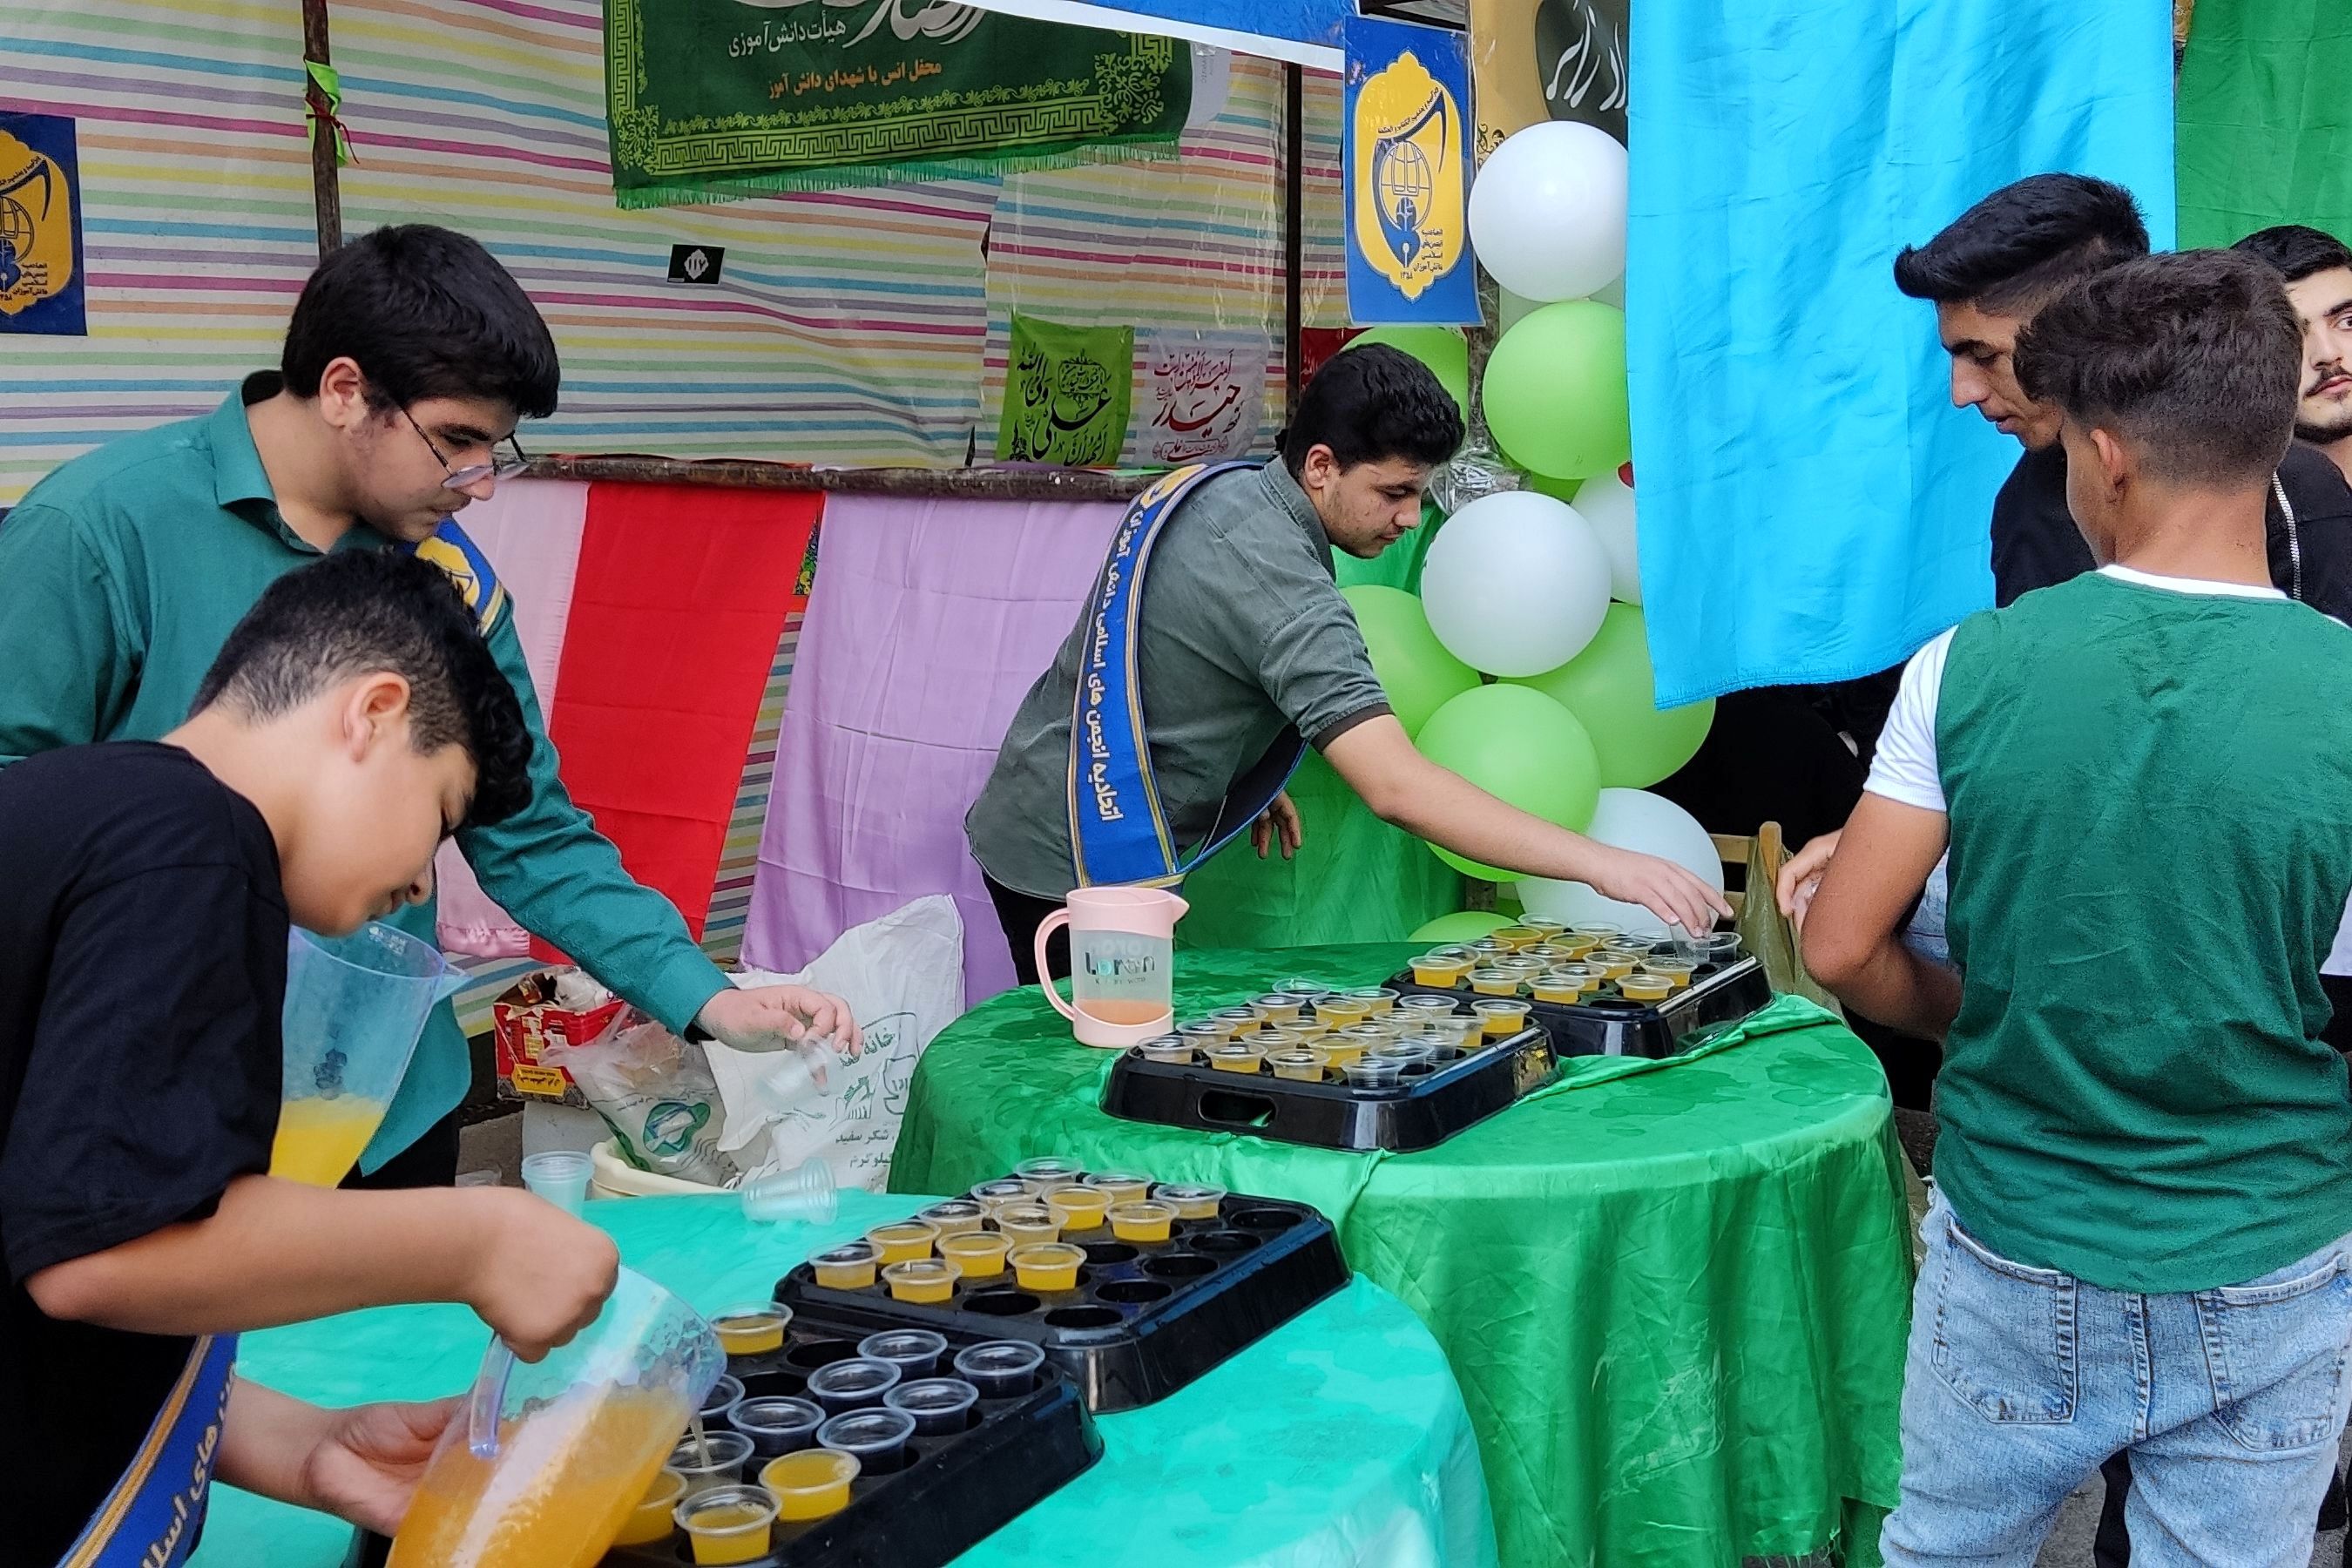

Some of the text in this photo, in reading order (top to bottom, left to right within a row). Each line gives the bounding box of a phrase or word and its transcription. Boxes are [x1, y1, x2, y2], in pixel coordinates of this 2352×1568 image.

[728, 20, 771, 57] آموزی
[768, 21, 806, 52] دانش
[768, 58, 943, 99] محفل انس با شهدای دانش آموز
[1102, 562, 1120, 609] دانش
[1093, 612, 1109, 668] اسلامی
[1088, 672, 1105, 706] های
[1086, 710, 1111, 759] انجمن
[1087, 762, 1124, 821] اتحادیه
